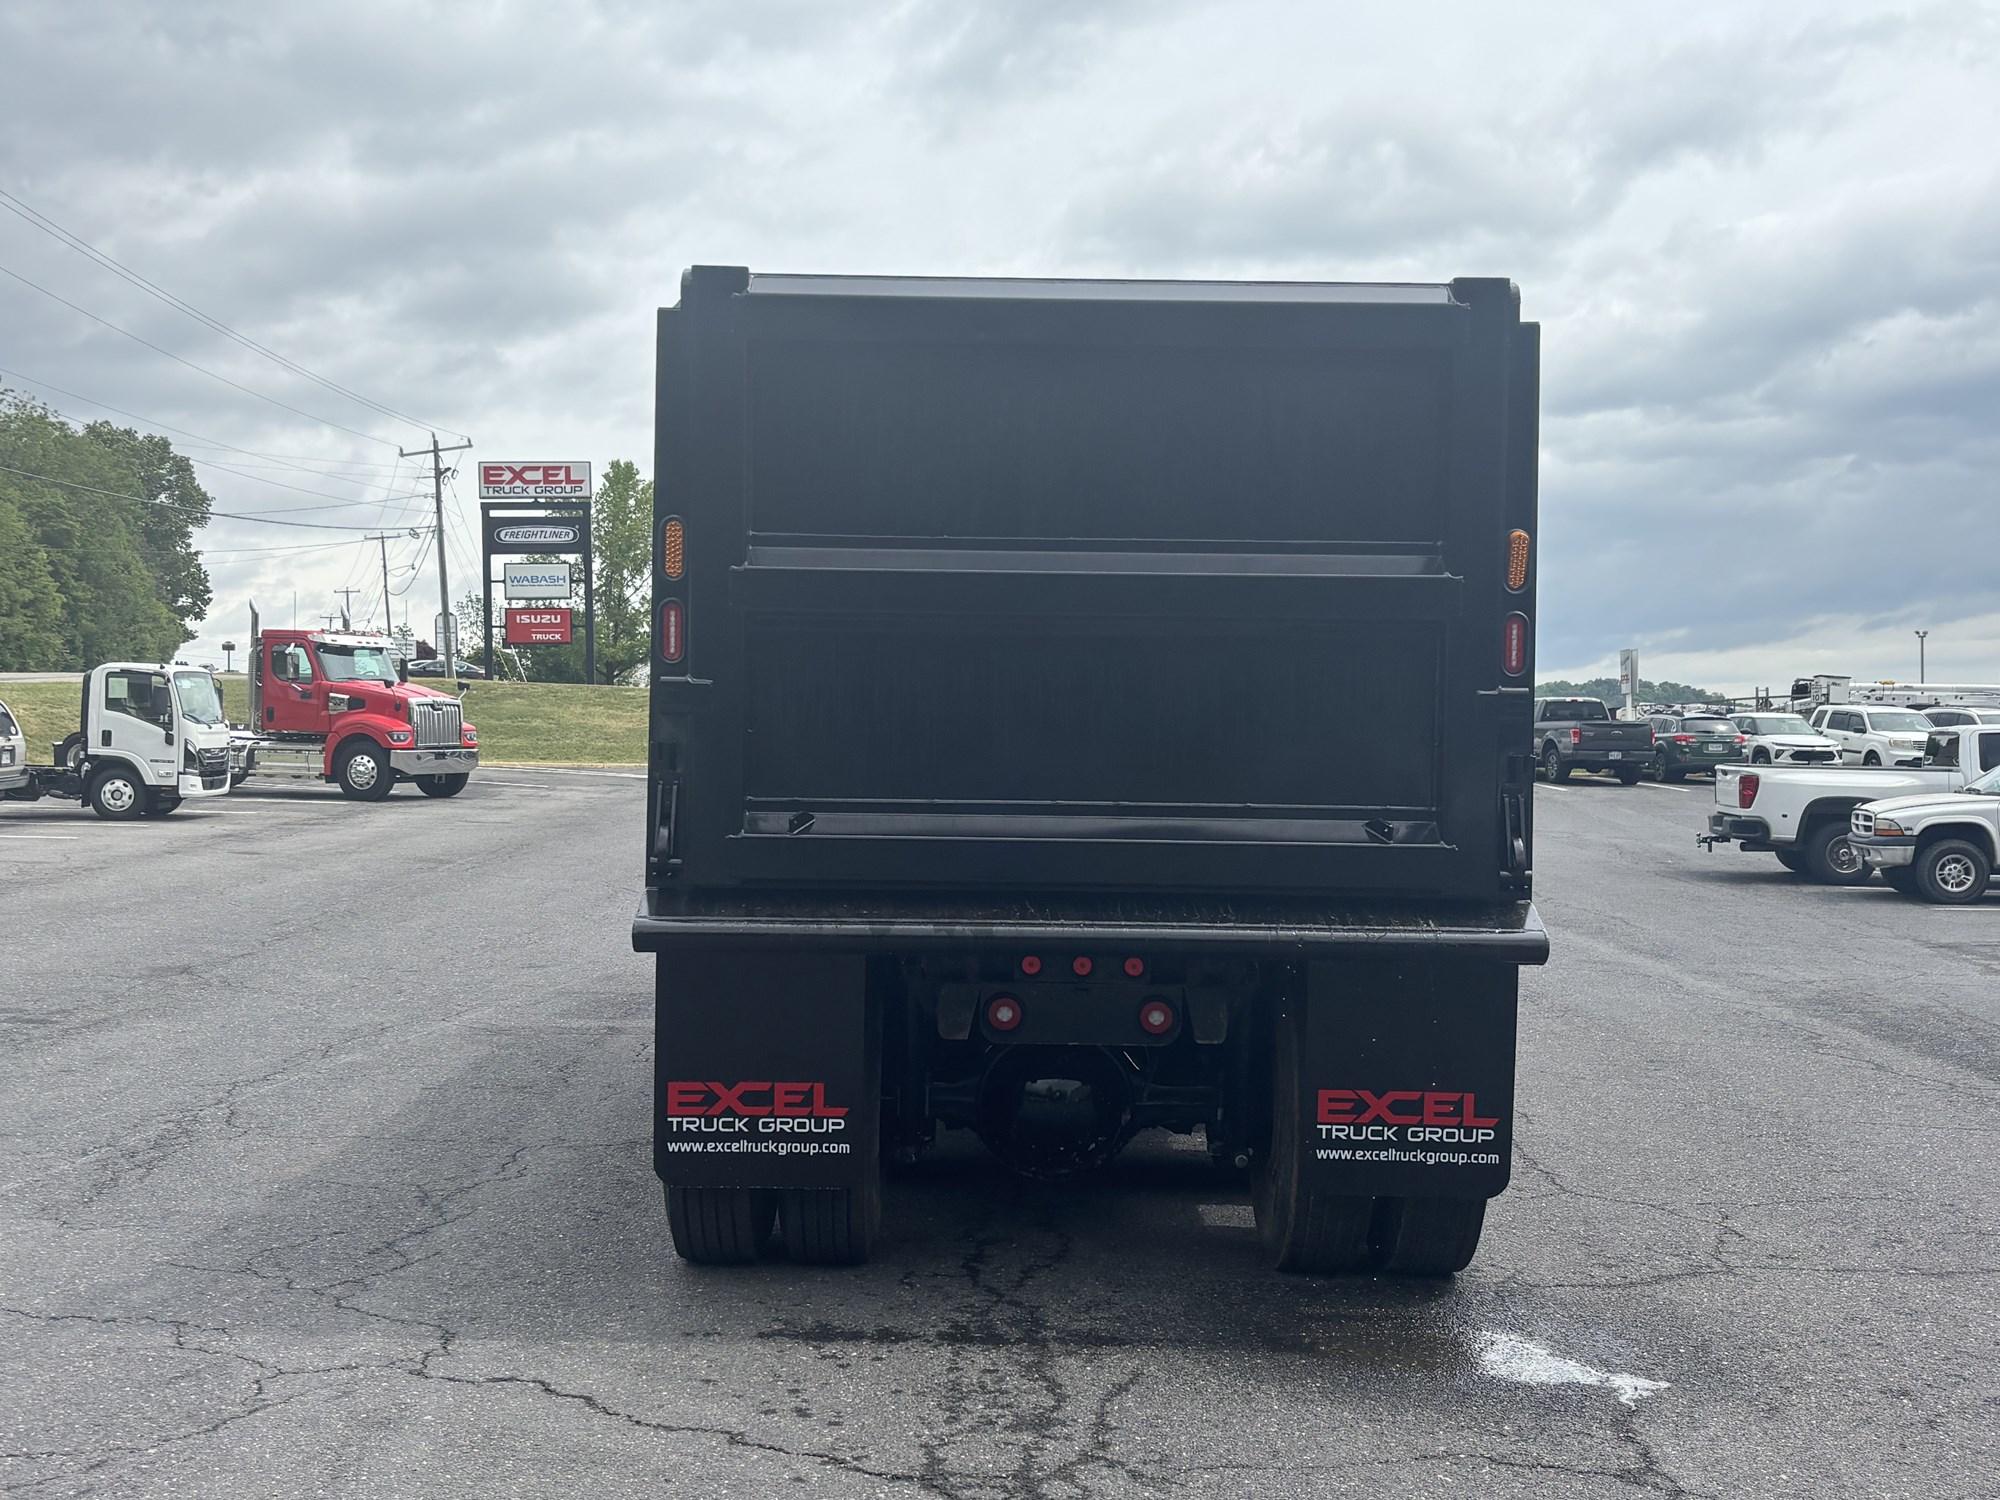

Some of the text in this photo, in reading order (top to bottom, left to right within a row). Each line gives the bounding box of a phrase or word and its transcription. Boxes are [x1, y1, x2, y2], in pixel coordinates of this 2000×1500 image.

[483, 465, 585, 485] EXCEL
[484, 485, 583, 495] TRUCK GROUP
[503, 529, 571, 540] FREIGHTLINER
[509, 575, 566, 584] WABASH
[516, 614, 561, 624] ISUZU
[531, 633, 562, 641] TRUCK
[667, 1081, 849, 1117] EXCEL
[1317, 1089, 1500, 1127] EXCEL
[667, 1117, 845, 1133] TRUCK GROUP
[1316, 1124, 1495, 1143] TRUCK GROUP
[667, 1139, 850, 1156] www.exceltruckgroup.com
[1315, 1148, 1500, 1166] www.exceltruckgroup.com
